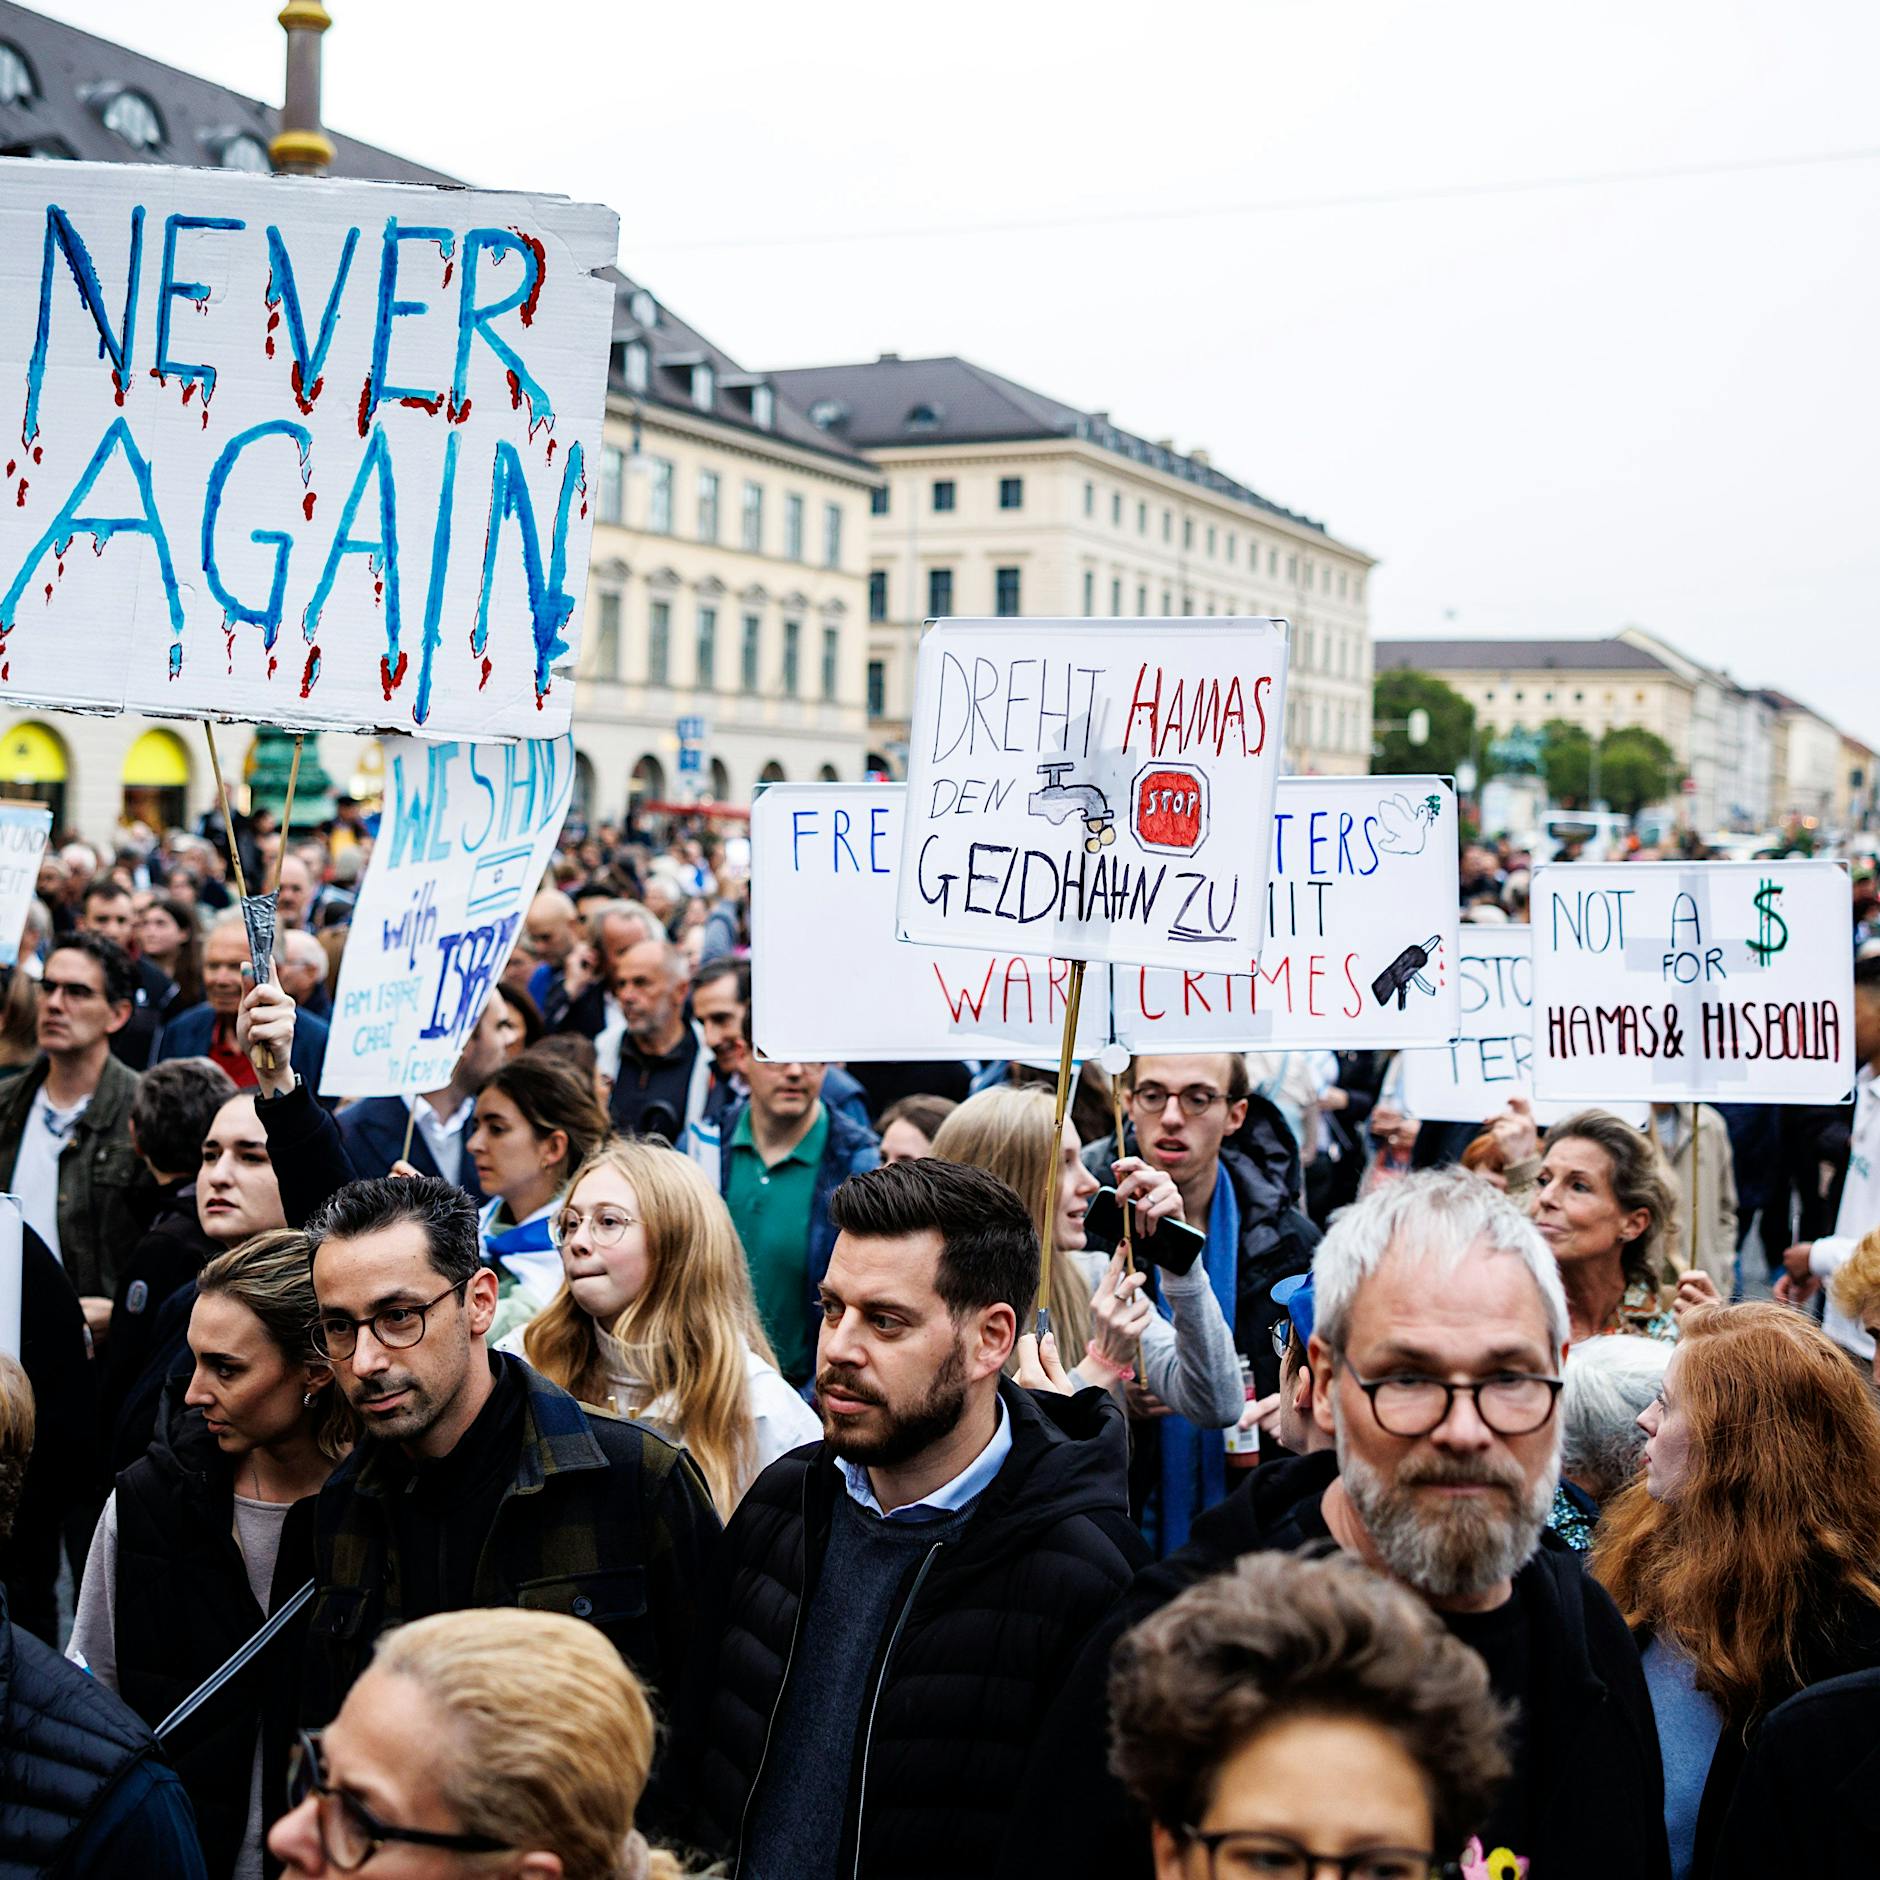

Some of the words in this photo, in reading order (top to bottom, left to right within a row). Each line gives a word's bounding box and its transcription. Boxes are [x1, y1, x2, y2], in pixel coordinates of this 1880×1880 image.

[22, 204, 555, 450] NEVER
[0, 417, 586, 722] AGAIN
[933, 651, 1107, 764] DREHT
[1123, 662, 1272, 757] HAMAS
[388, 741, 459, 869] WE
[928, 778, 1016, 820] DEN
[1145, 790, 1198, 818] STOP
[918, 835, 1166, 925] GELDHAHN
[1173, 873, 1238, 934] ZU
[1553, 891, 1636, 954] NOT
[1671, 892, 1700, 949] A
[1745, 877, 1789, 968] $
[933, 957, 1071, 1024] WAR
[1663, 948, 1727, 984] FOR
